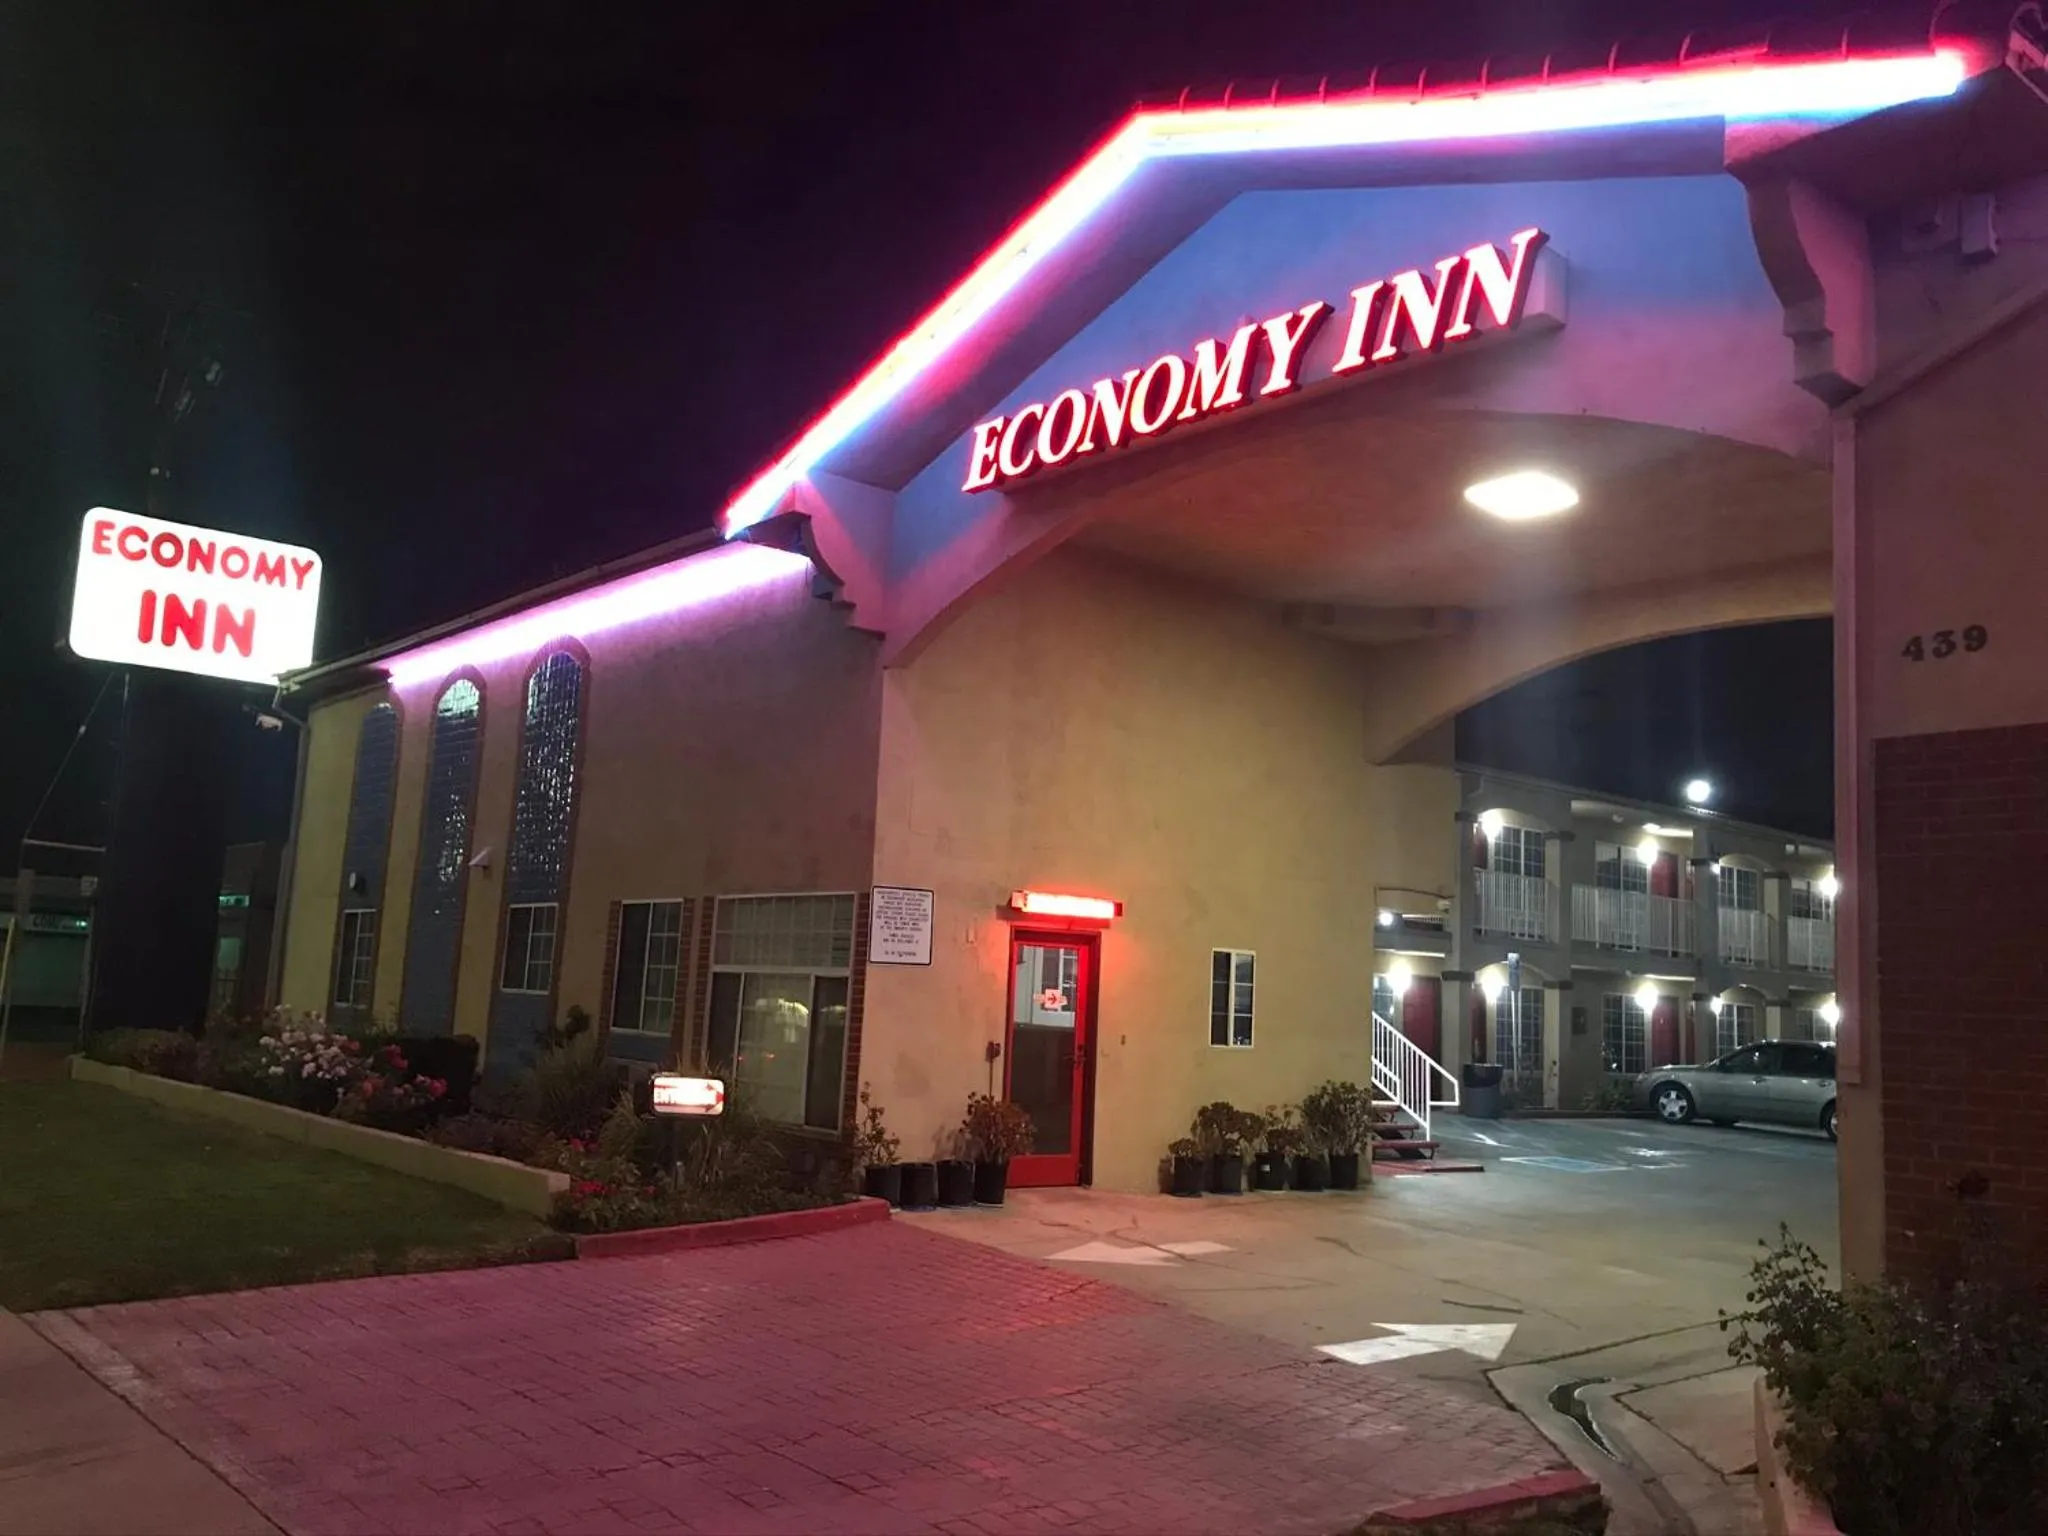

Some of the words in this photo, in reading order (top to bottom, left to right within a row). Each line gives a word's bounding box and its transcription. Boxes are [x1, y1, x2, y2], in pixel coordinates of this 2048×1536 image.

[961, 300, 1329, 493] ECONOMY
[1331, 227, 1544, 374] INN
[92, 520, 315, 590] ECONOMY
[138, 590, 256, 658] INN
[1901, 624, 1987, 661] 439
